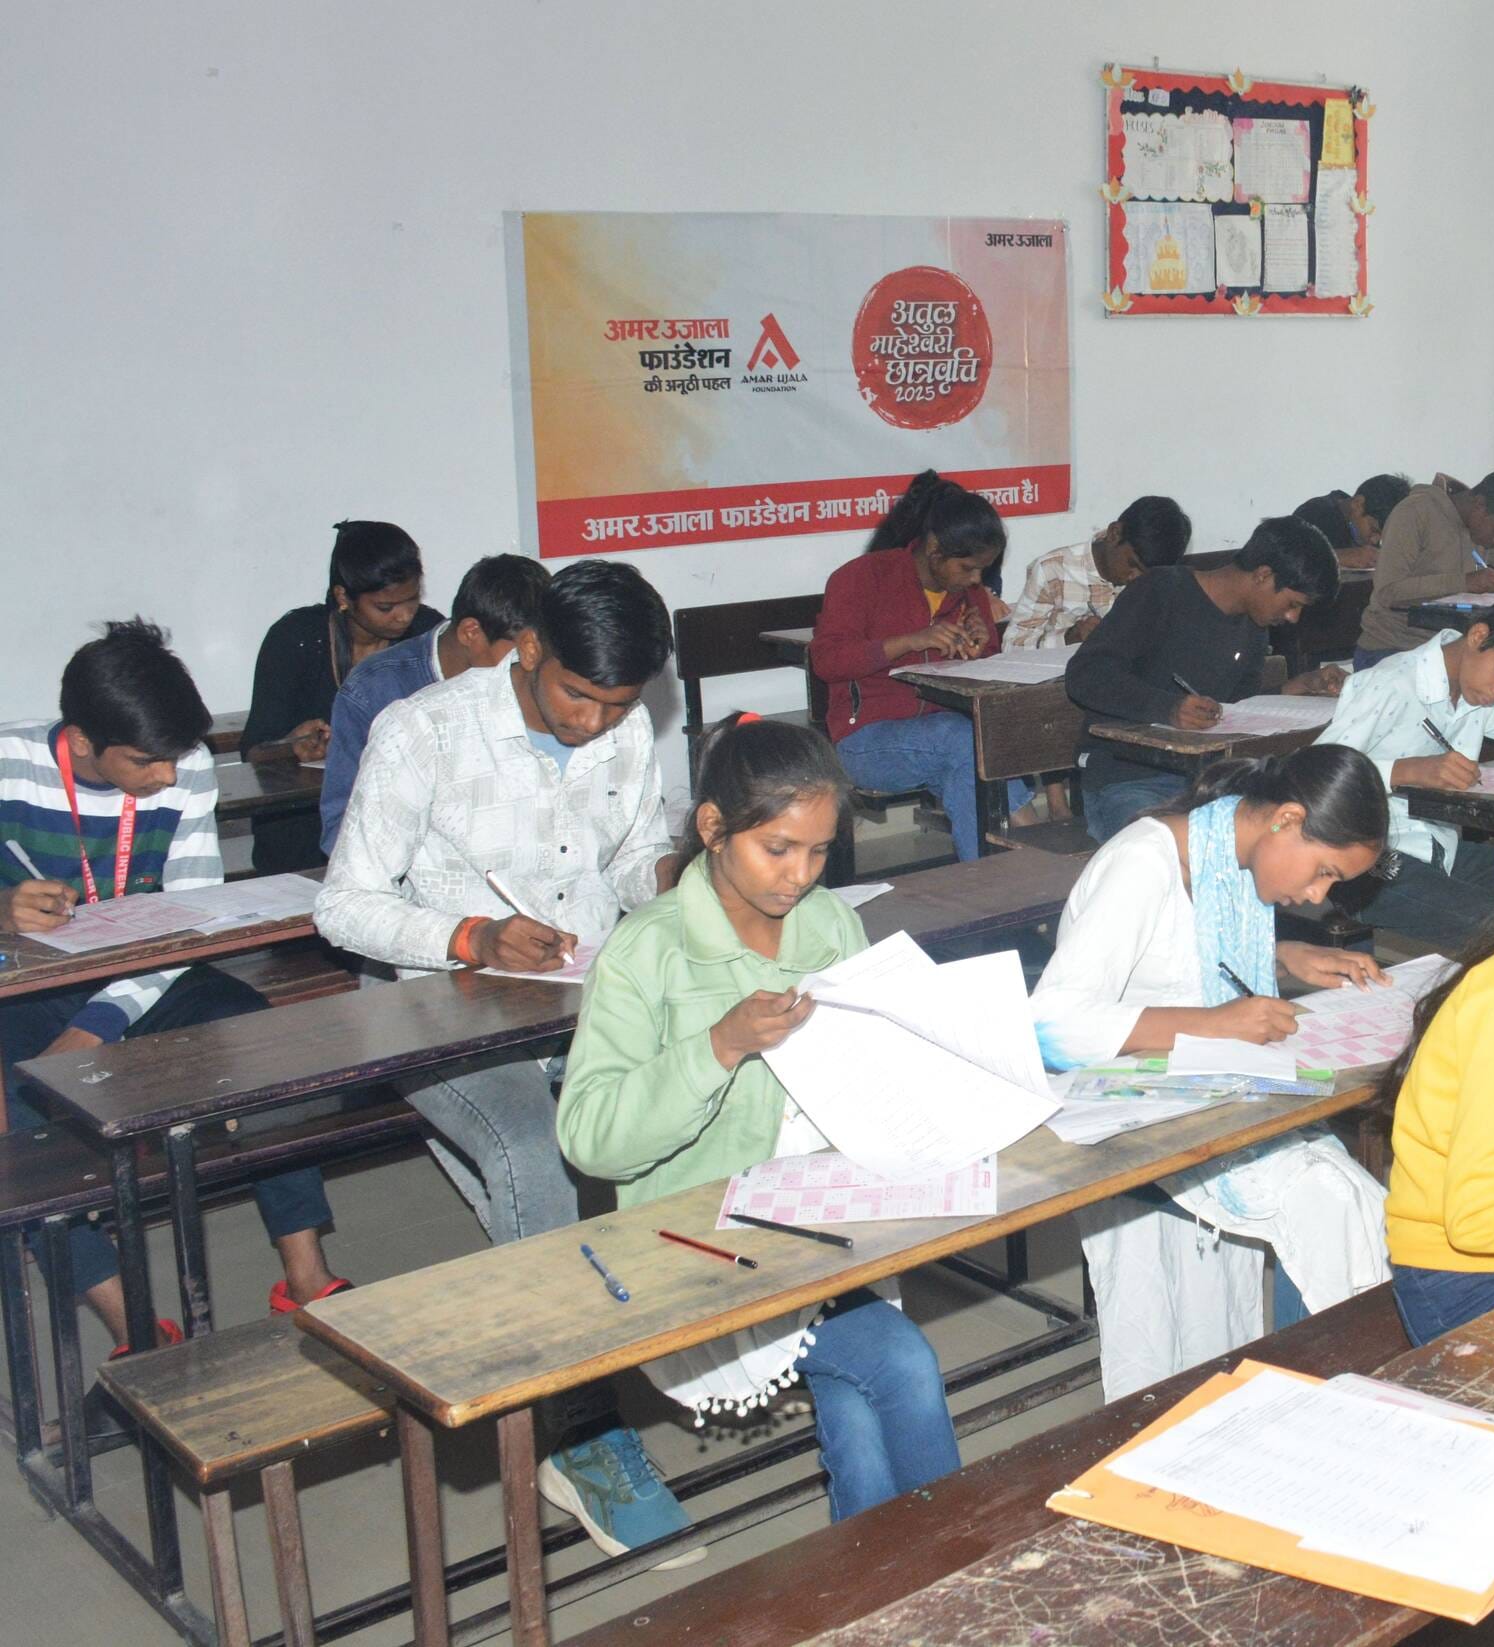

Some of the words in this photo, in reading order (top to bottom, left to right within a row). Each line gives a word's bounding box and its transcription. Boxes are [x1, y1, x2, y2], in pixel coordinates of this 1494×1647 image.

[985, 233, 1014, 247] अमर
[1015, 234, 1053, 248] उजाला
[604, 319, 660, 341] अमर
[661, 318, 730, 340] उजाला
[891, 300, 959, 334] अतुल
[639, 341, 732, 371] फाउंडेशन
[869, 326, 955, 359] माहेश्वरी
[643, 375, 663, 392] की
[664, 373, 700, 395] अनूठी
[701, 377, 732, 391] पहल
[741, 374, 773, 384] AMAR
[776, 373, 808, 385] UJALA
[885, 347, 981, 395] छात्रवृत्ति
[895, 386, 936, 402] 2025
[581, 515, 641, 542] अमर
[642, 509, 715, 536] उजाला
[720, 496, 811, 528] फाउंडेशन
[815, 498, 852, 520] आप
[854, 488, 891, 516] सभी
[119, 810, 135, 852] PUBLIC
[117, 855, 129, 889] INTER
